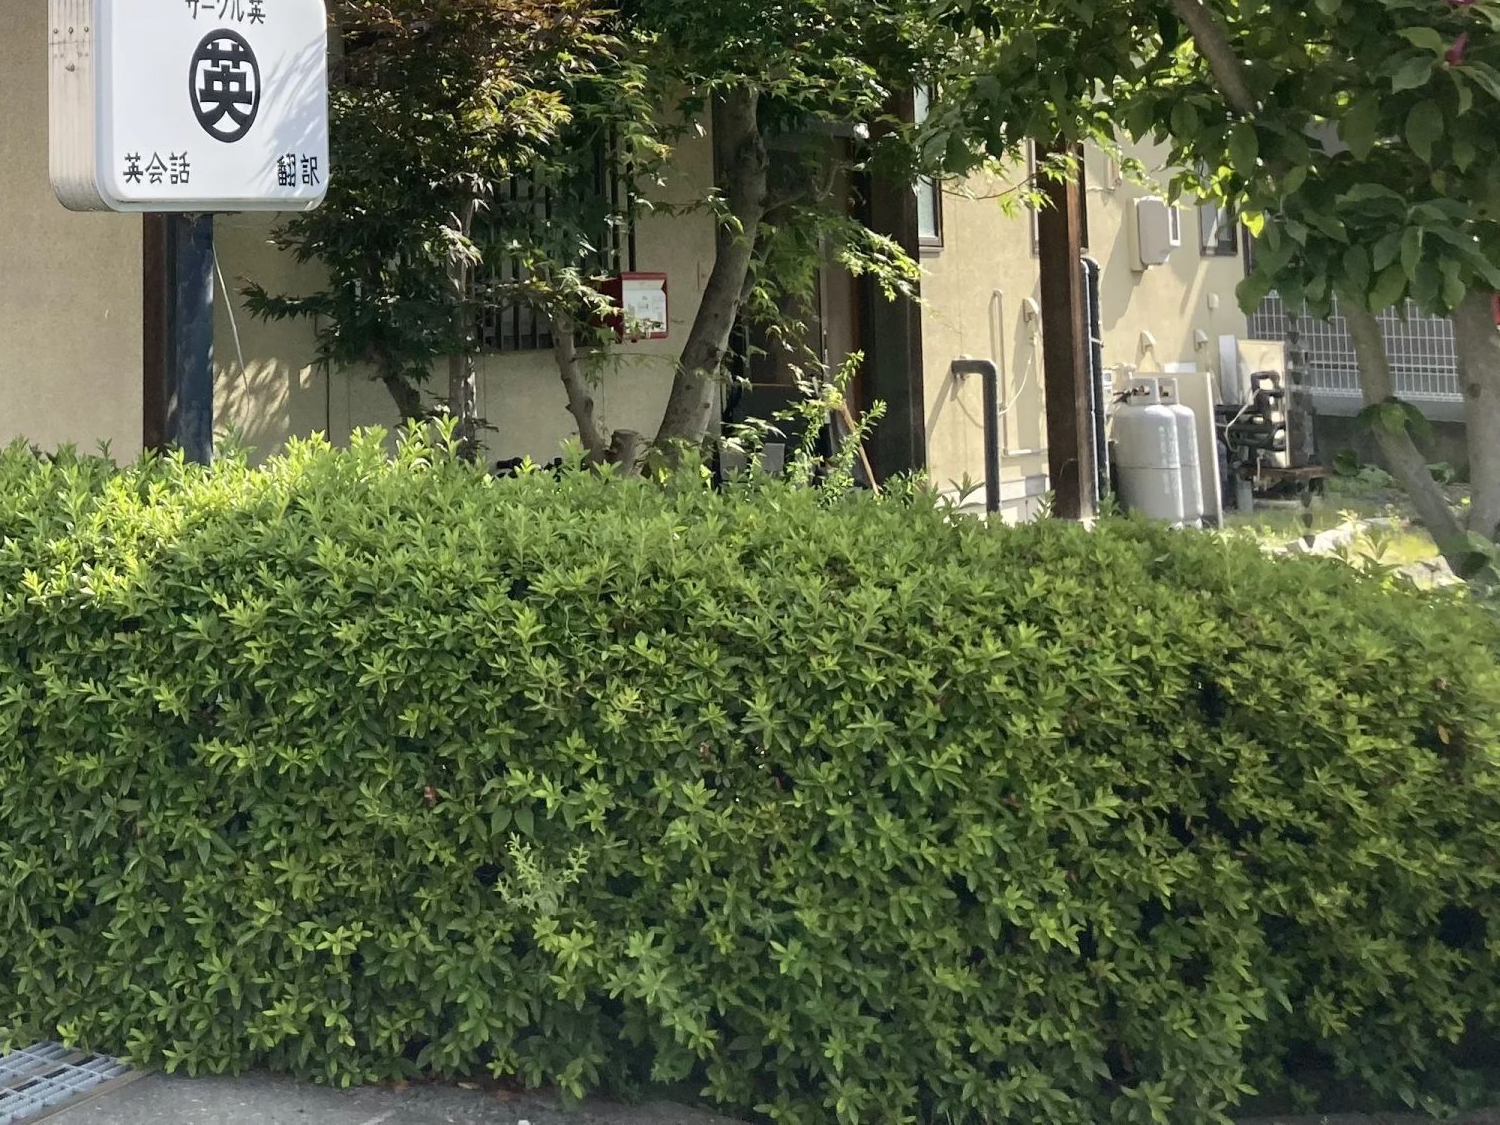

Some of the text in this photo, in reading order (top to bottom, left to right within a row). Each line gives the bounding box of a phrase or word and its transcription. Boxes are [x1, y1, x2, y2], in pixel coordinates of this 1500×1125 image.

[192, 35, 258, 135] 英
[123, 151, 190, 185] 英会話
[277, 153, 320, 187] 翻訳
